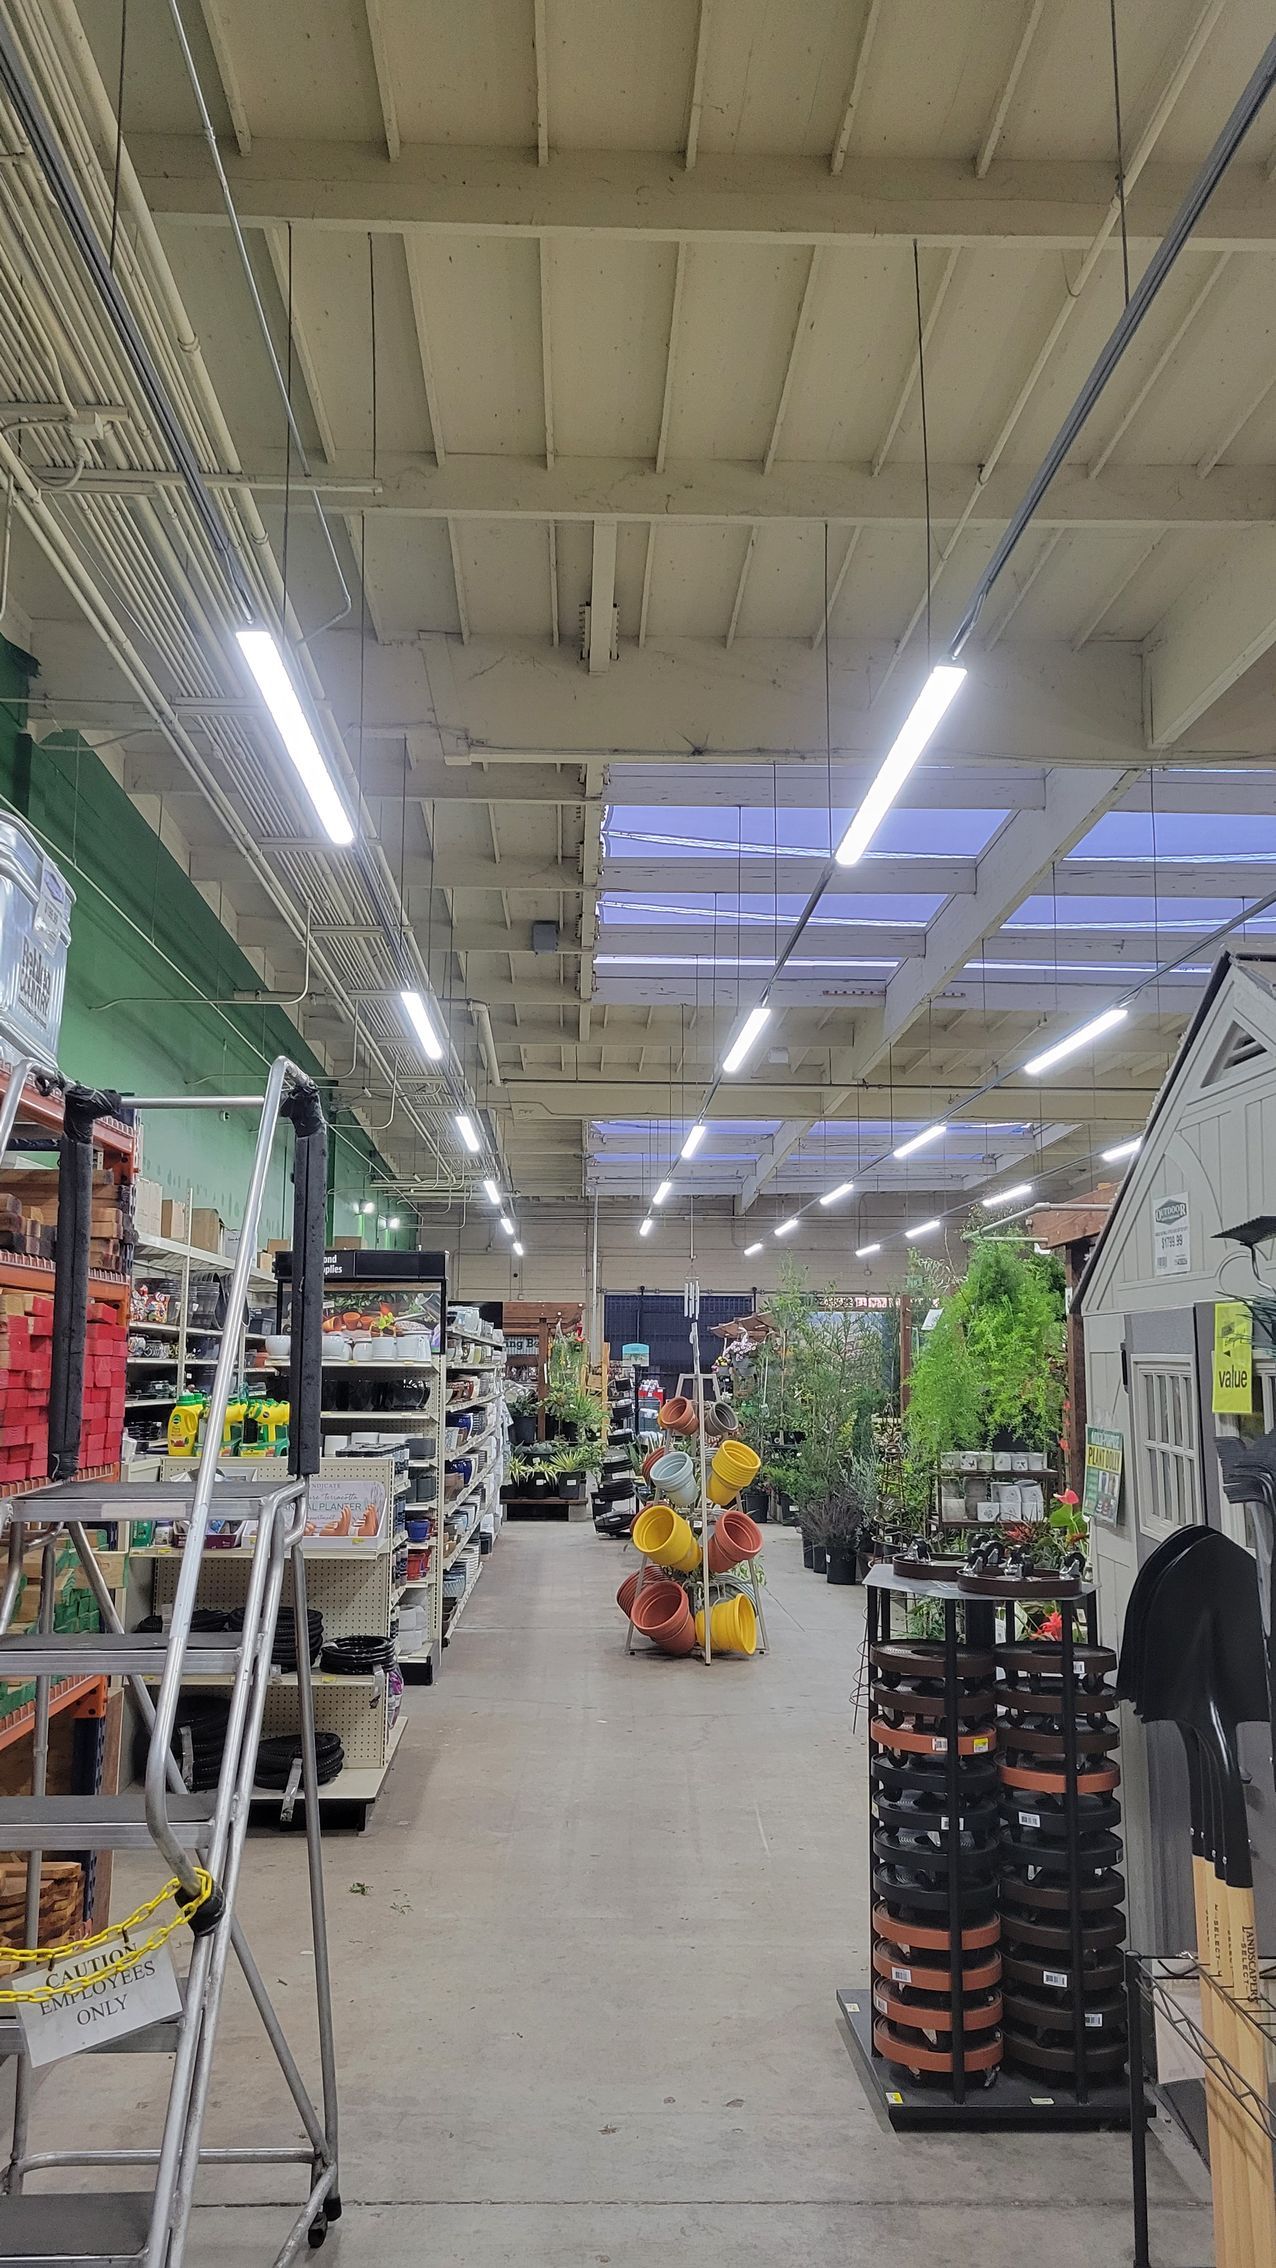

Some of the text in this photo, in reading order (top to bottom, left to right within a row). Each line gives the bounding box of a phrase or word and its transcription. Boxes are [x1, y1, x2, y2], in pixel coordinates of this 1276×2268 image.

[323, 1254, 337, 1264] ond
[505, 1338, 540, 1350] ing Be
[1218, 1364, 1248, 1388] value
[1213, 1919, 1221, 1960] SELECT
[45, 1943, 138, 1989] CAUTION
[1240, 1942, 1249, 1985] SELECT
[39, 1960, 156, 2016] EMPLOYEES
[76, 1993, 129, 2026] ONLY
